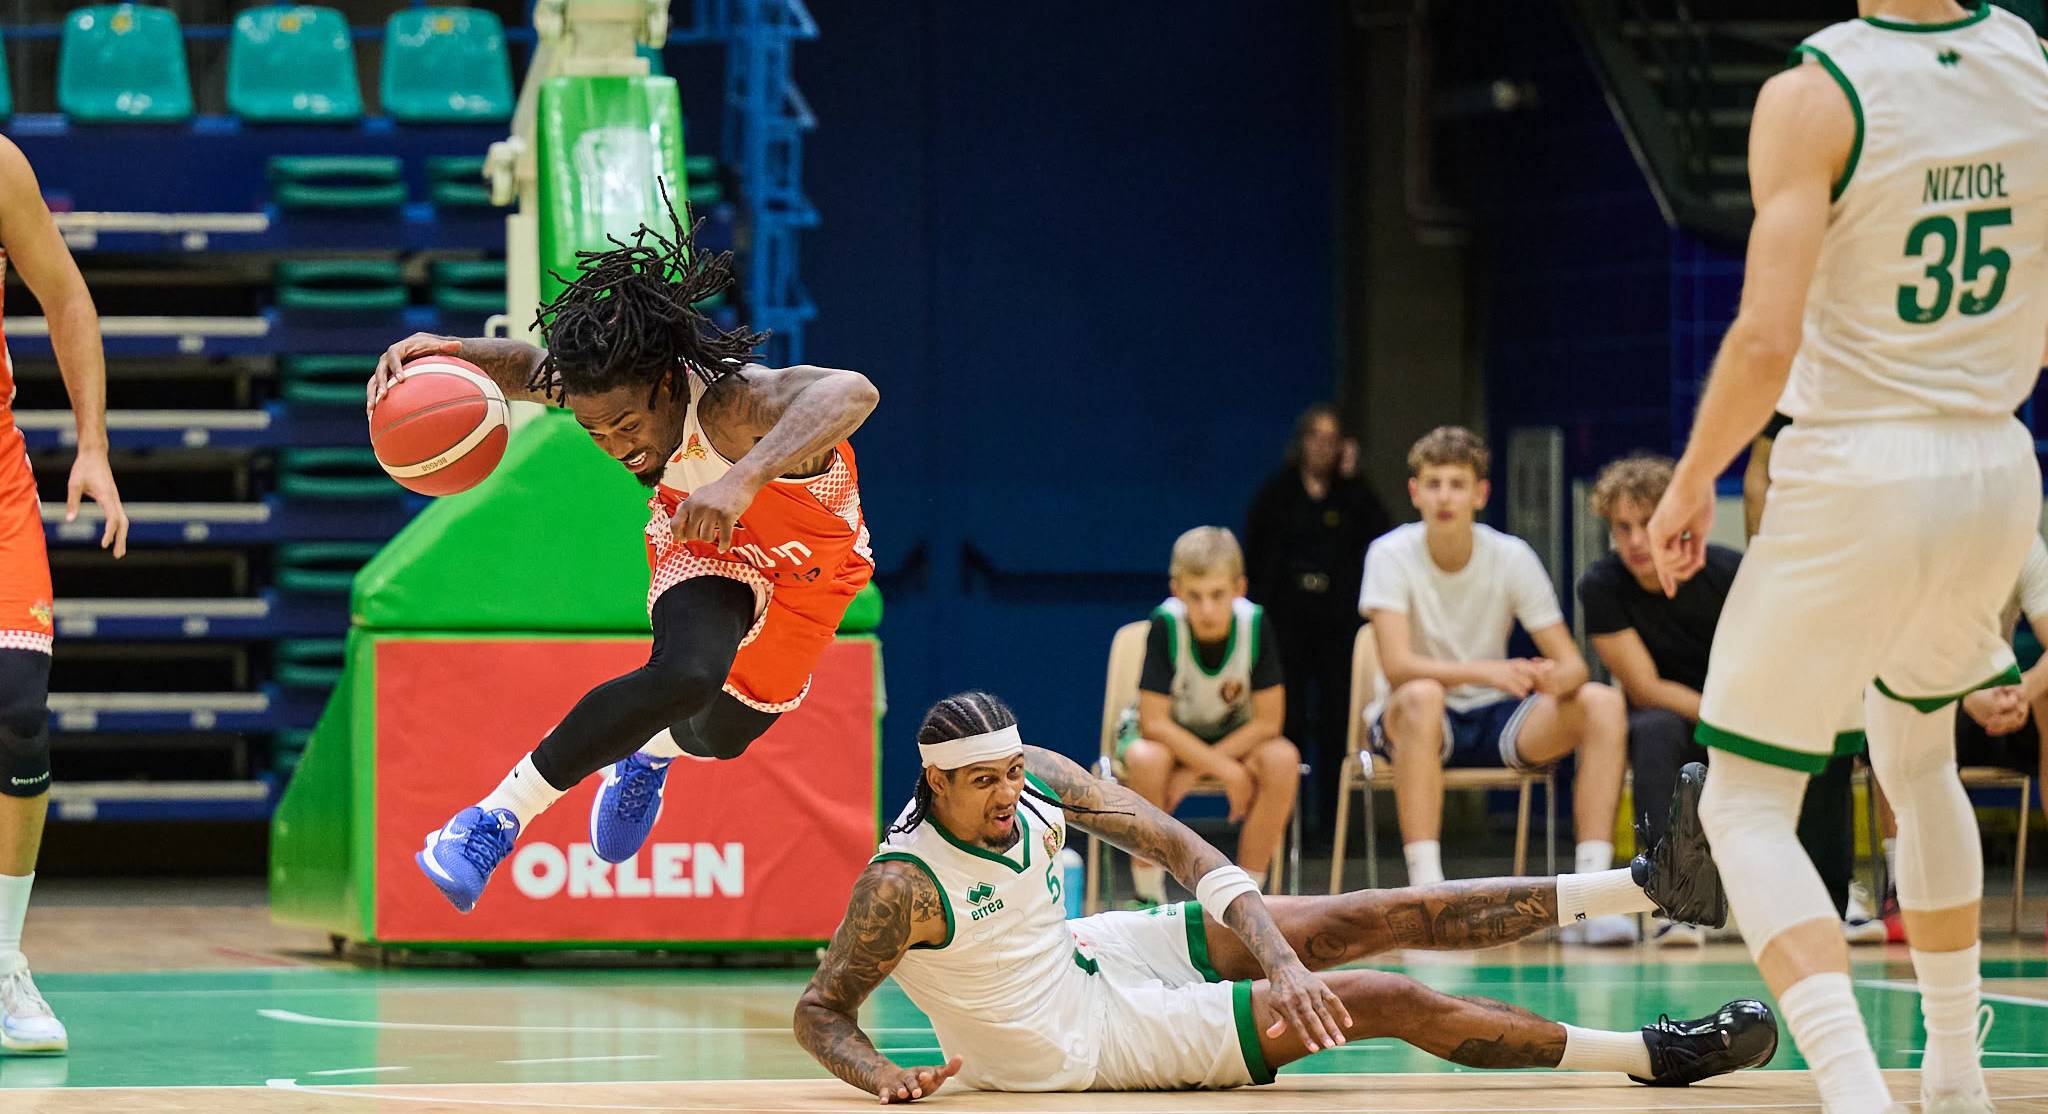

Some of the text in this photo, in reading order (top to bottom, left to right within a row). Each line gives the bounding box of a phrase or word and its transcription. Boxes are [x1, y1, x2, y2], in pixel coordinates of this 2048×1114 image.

[1923, 162, 2009, 203] NIZIOŁ
[1896, 207, 2013, 324] 35
[511, 841, 745, 900] ORLEN
[971, 898, 1004, 921] errea
